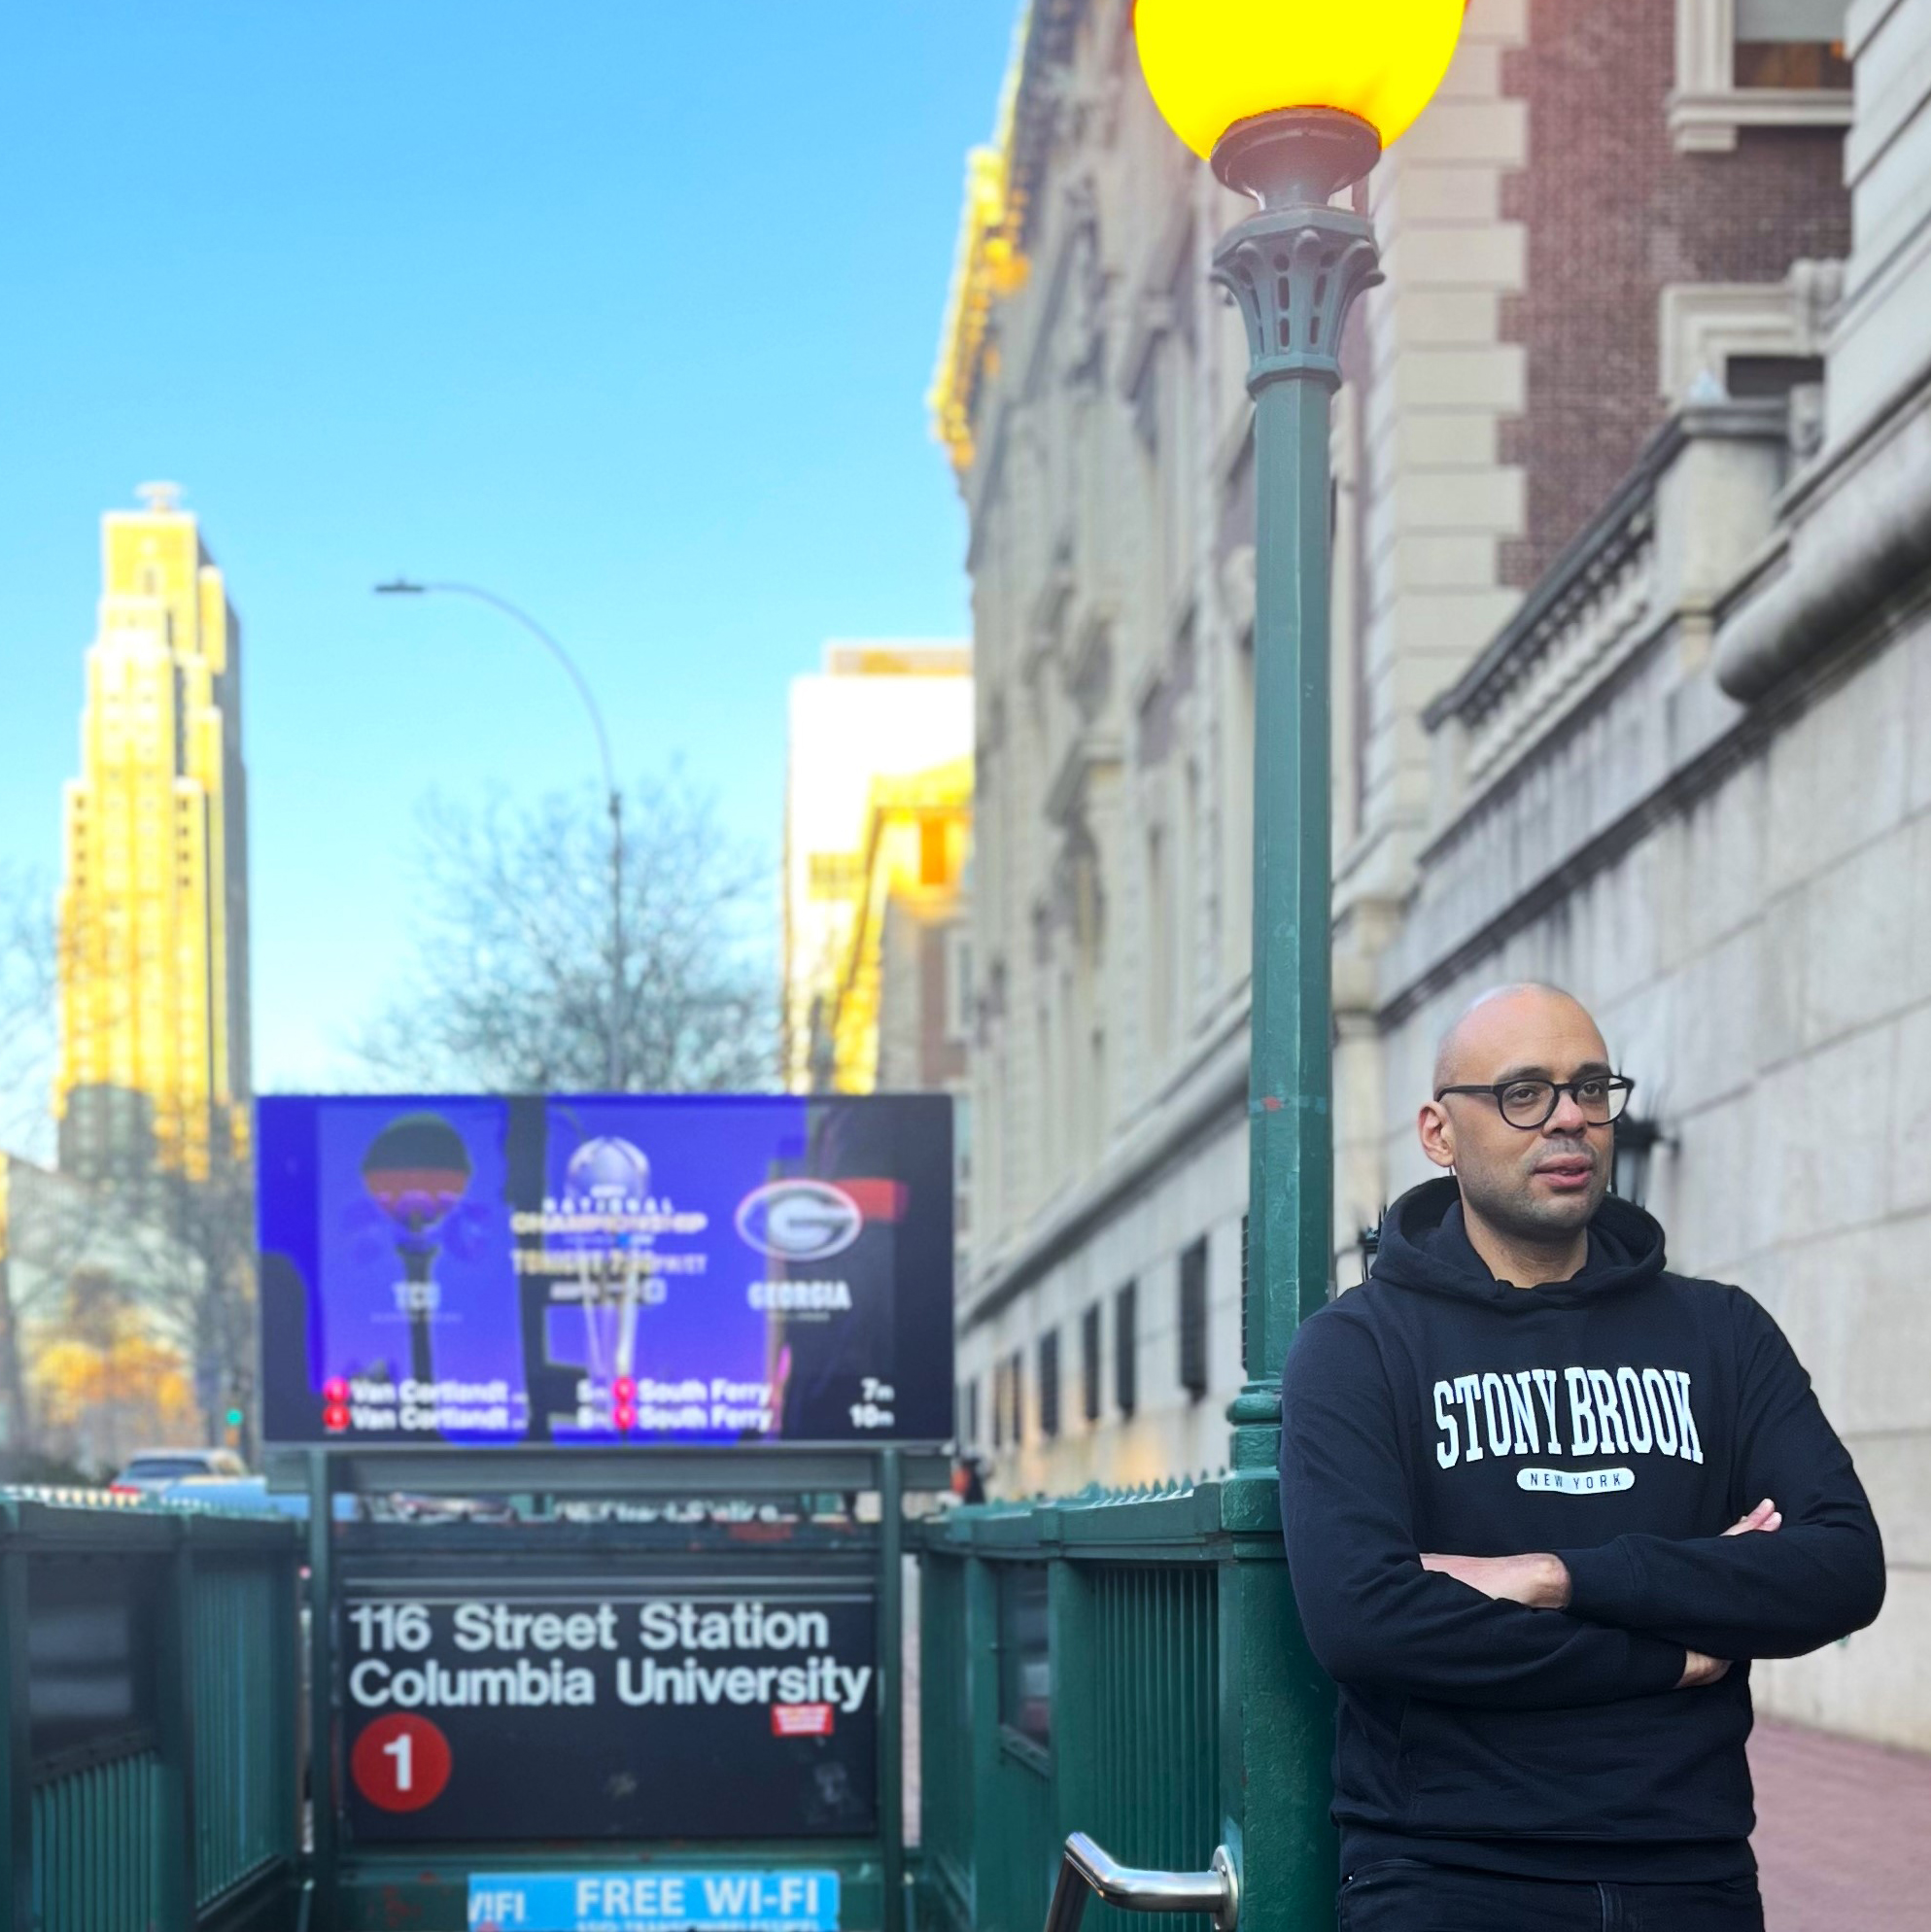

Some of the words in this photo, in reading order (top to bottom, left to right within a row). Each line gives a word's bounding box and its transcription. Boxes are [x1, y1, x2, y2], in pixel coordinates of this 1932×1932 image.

[746, 1280, 852, 1312] GEORGIA
[350, 1378, 397, 1404] Van
[638, 1377, 708, 1403] South
[710, 1377, 774, 1407] Ferry
[350, 1405, 397, 1431] Van
[638, 1405, 708, 1431] South
[710, 1405, 774, 1433] Ferry
[1433, 1368, 1562, 1469] STONY
[1564, 1366, 1704, 1465] BROOK
[1530, 1472, 1563, 1488] NEW
[1572, 1472, 1621, 1490] YORK
[349, 1603, 431, 1651] 116
[453, 1602, 618, 1651] Street
[638, 1602, 829, 1650] Station
[349, 1658, 596, 1708] Columbia
[616, 1655, 873, 1713] University
[383, 1733, 412, 1791] 1
[575, 1878, 685, 1915] FREE
[703, 1876, 819, 1915] WI-FI
